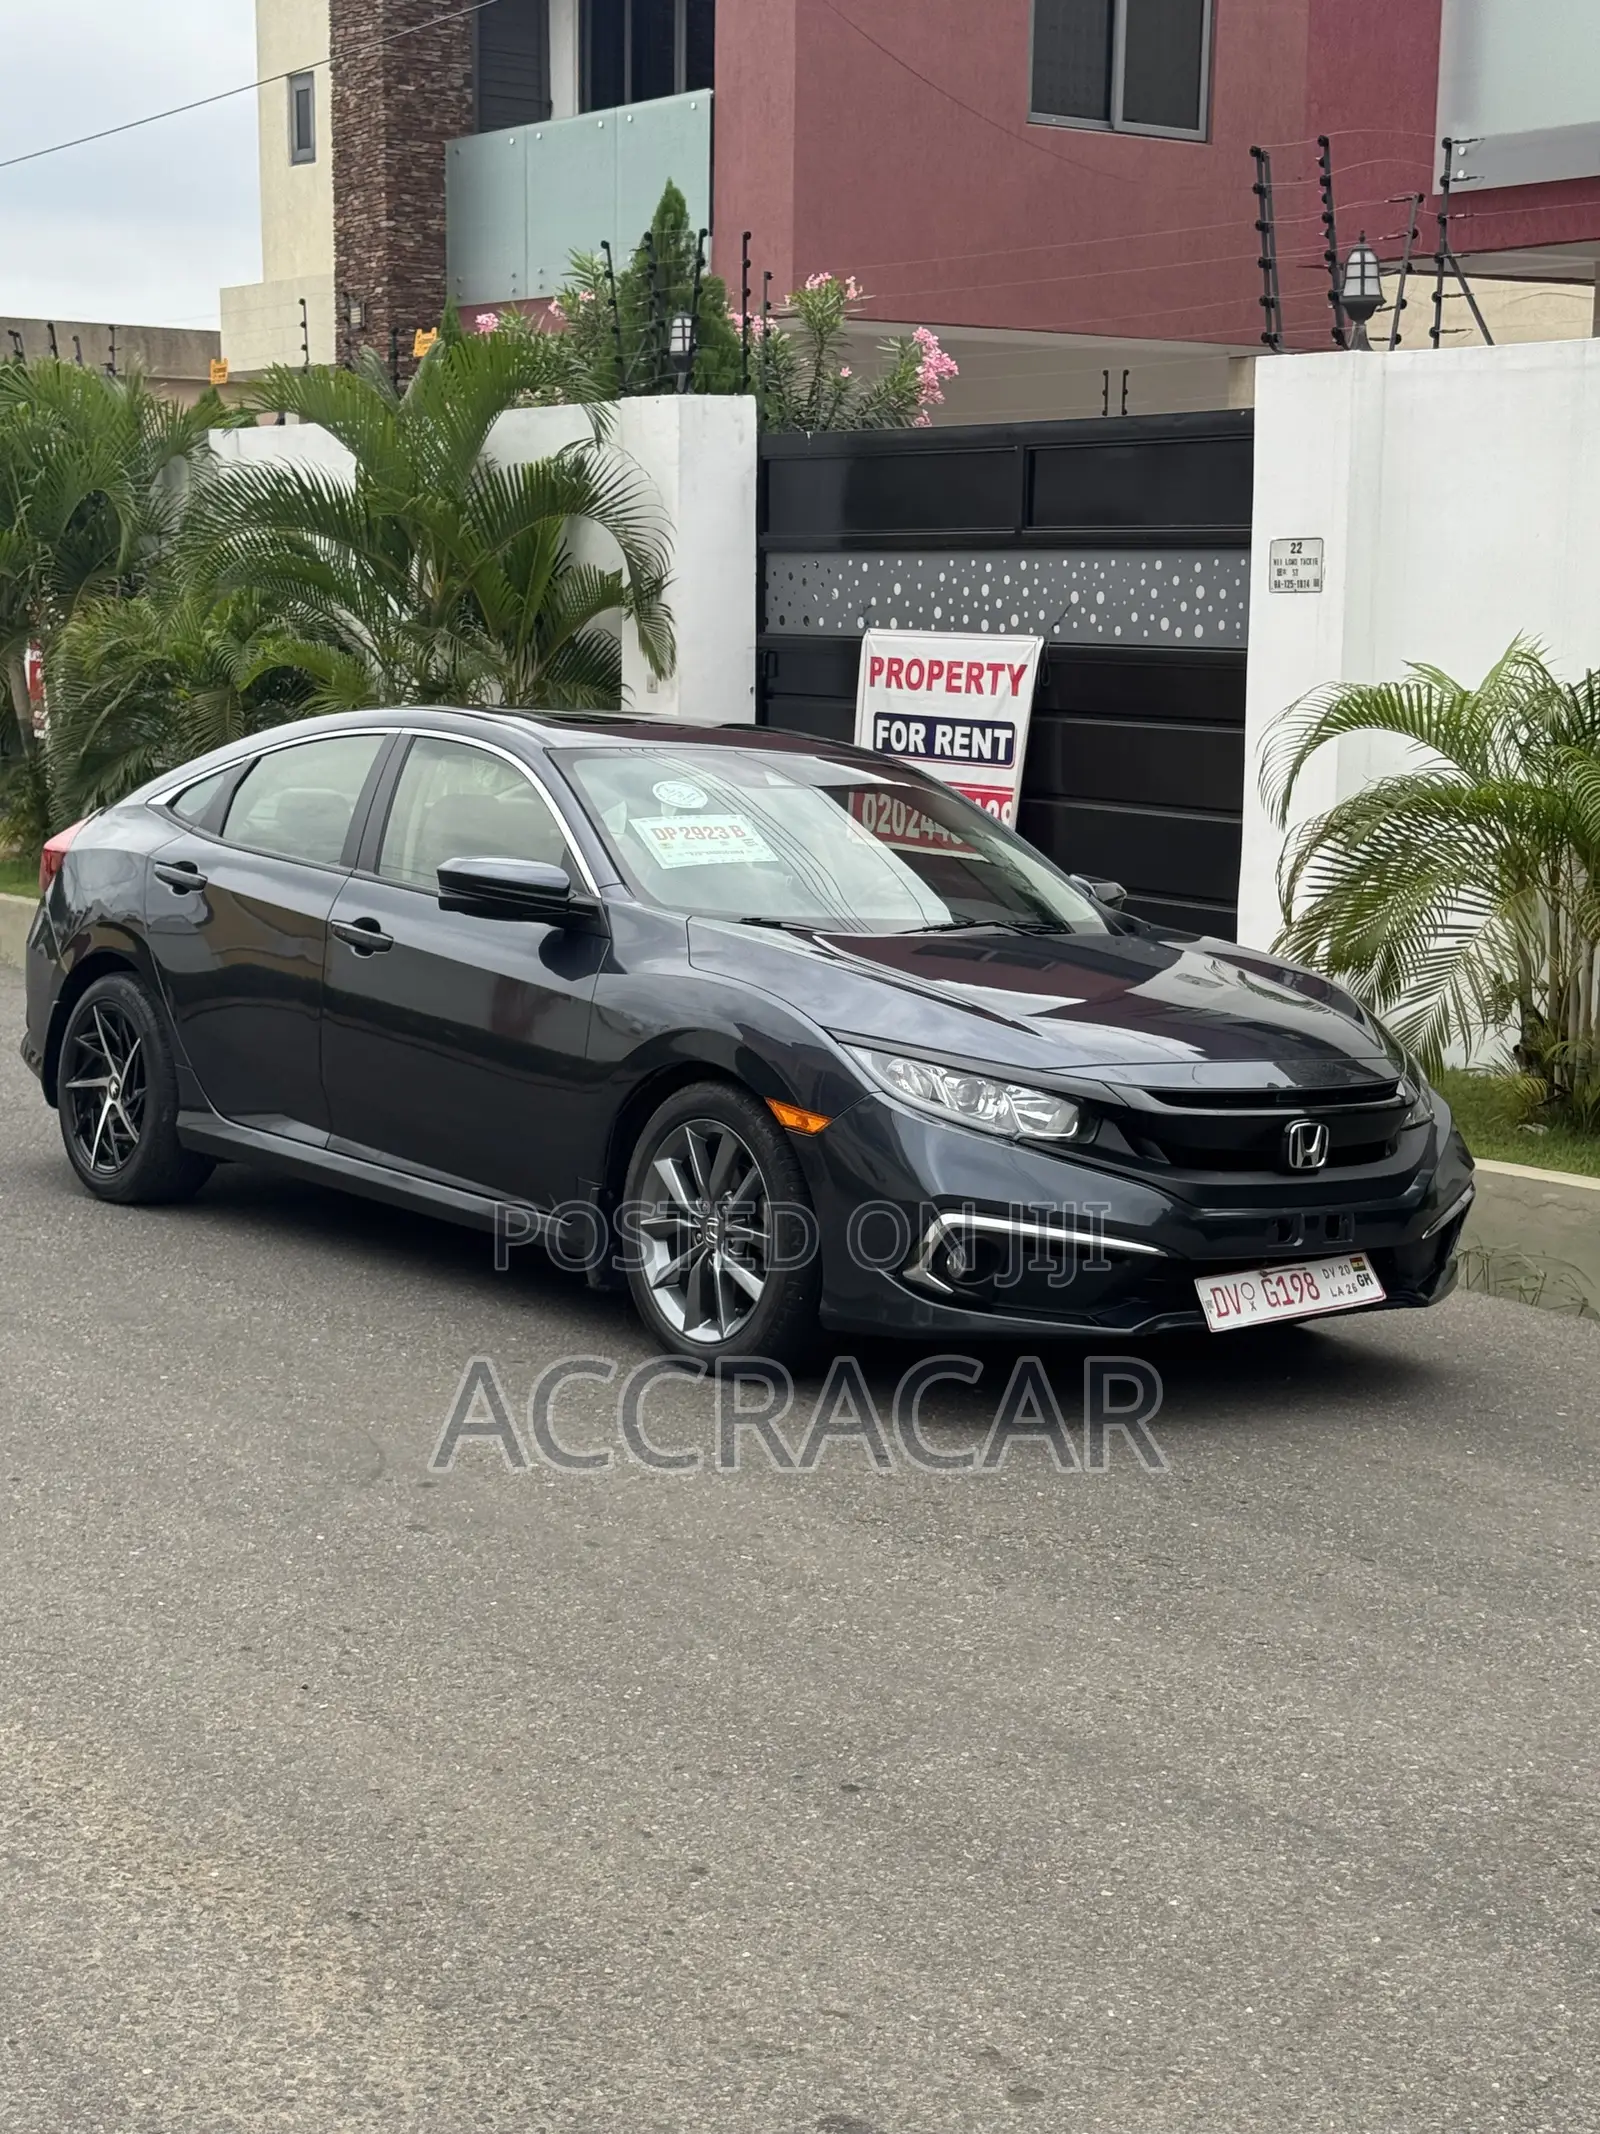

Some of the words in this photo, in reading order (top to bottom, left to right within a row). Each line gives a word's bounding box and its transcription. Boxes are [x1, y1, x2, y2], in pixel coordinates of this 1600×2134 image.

[1290, 541, 1303, 554] 22
[869, 656, 1028, 697] PROPERTY
[876, 719, 926, 754] FOR
[934, 724, 1013, 761] RENT
[651, 827, 678, 841] DP
[679, 825, 729, 840] 2923
[729, 825, 747, 839] B
[1321, 1266, 1335, 1280] DV
[1338, 1264, 1351, 1277] 20
[1356, 1273, 1374, 1288] GH
[1210, 1284, 1242, 1318] DV
[1261, 1272, 1321, 1308] G198
[1329, 1286, 1345, 1298] LA
[1345, 1283, 1358, 1295] 26
